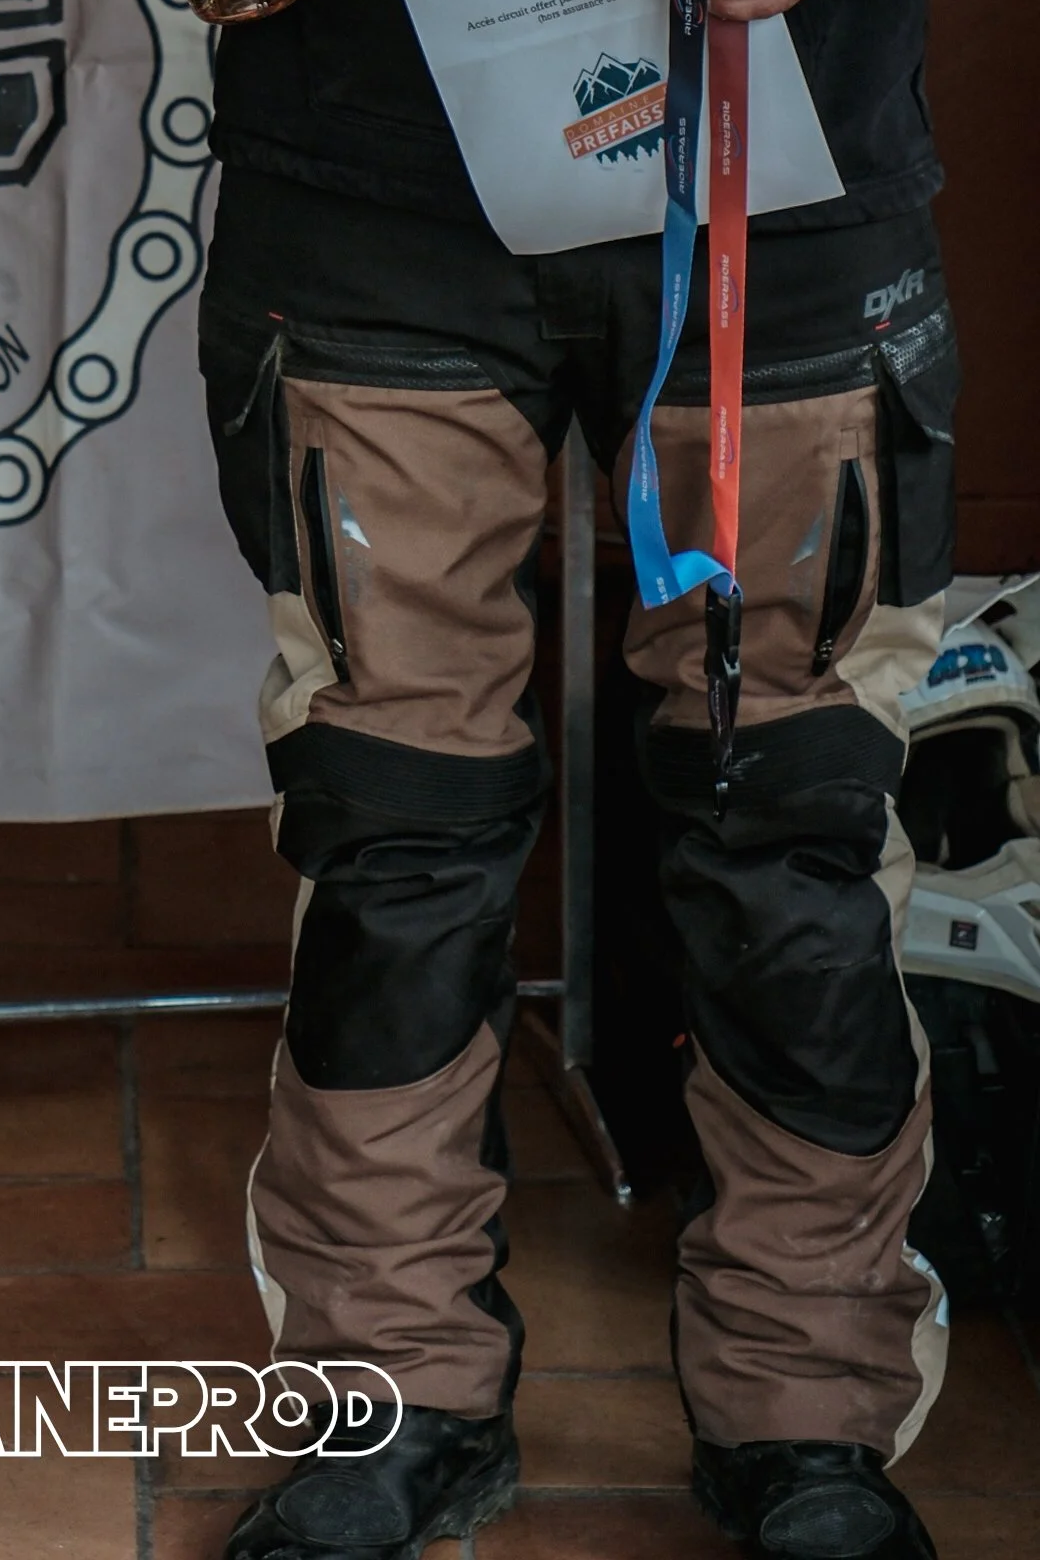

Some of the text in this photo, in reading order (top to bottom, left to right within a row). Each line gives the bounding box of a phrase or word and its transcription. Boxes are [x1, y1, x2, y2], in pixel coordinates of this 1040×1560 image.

[467, 17, 496, 32] Accès
[497, 7, 530, 23] circuit
[537, 11, 560, 25] (hors
[562, 0, 605, 17] assurance
[570, 104, 664, 156] PREFAISS
[678, 117, 687, 194] RIDERPASS
[722, 100, 731, 176] RIDERPASS
[721, 253, 729, 329] RIDERPASS
